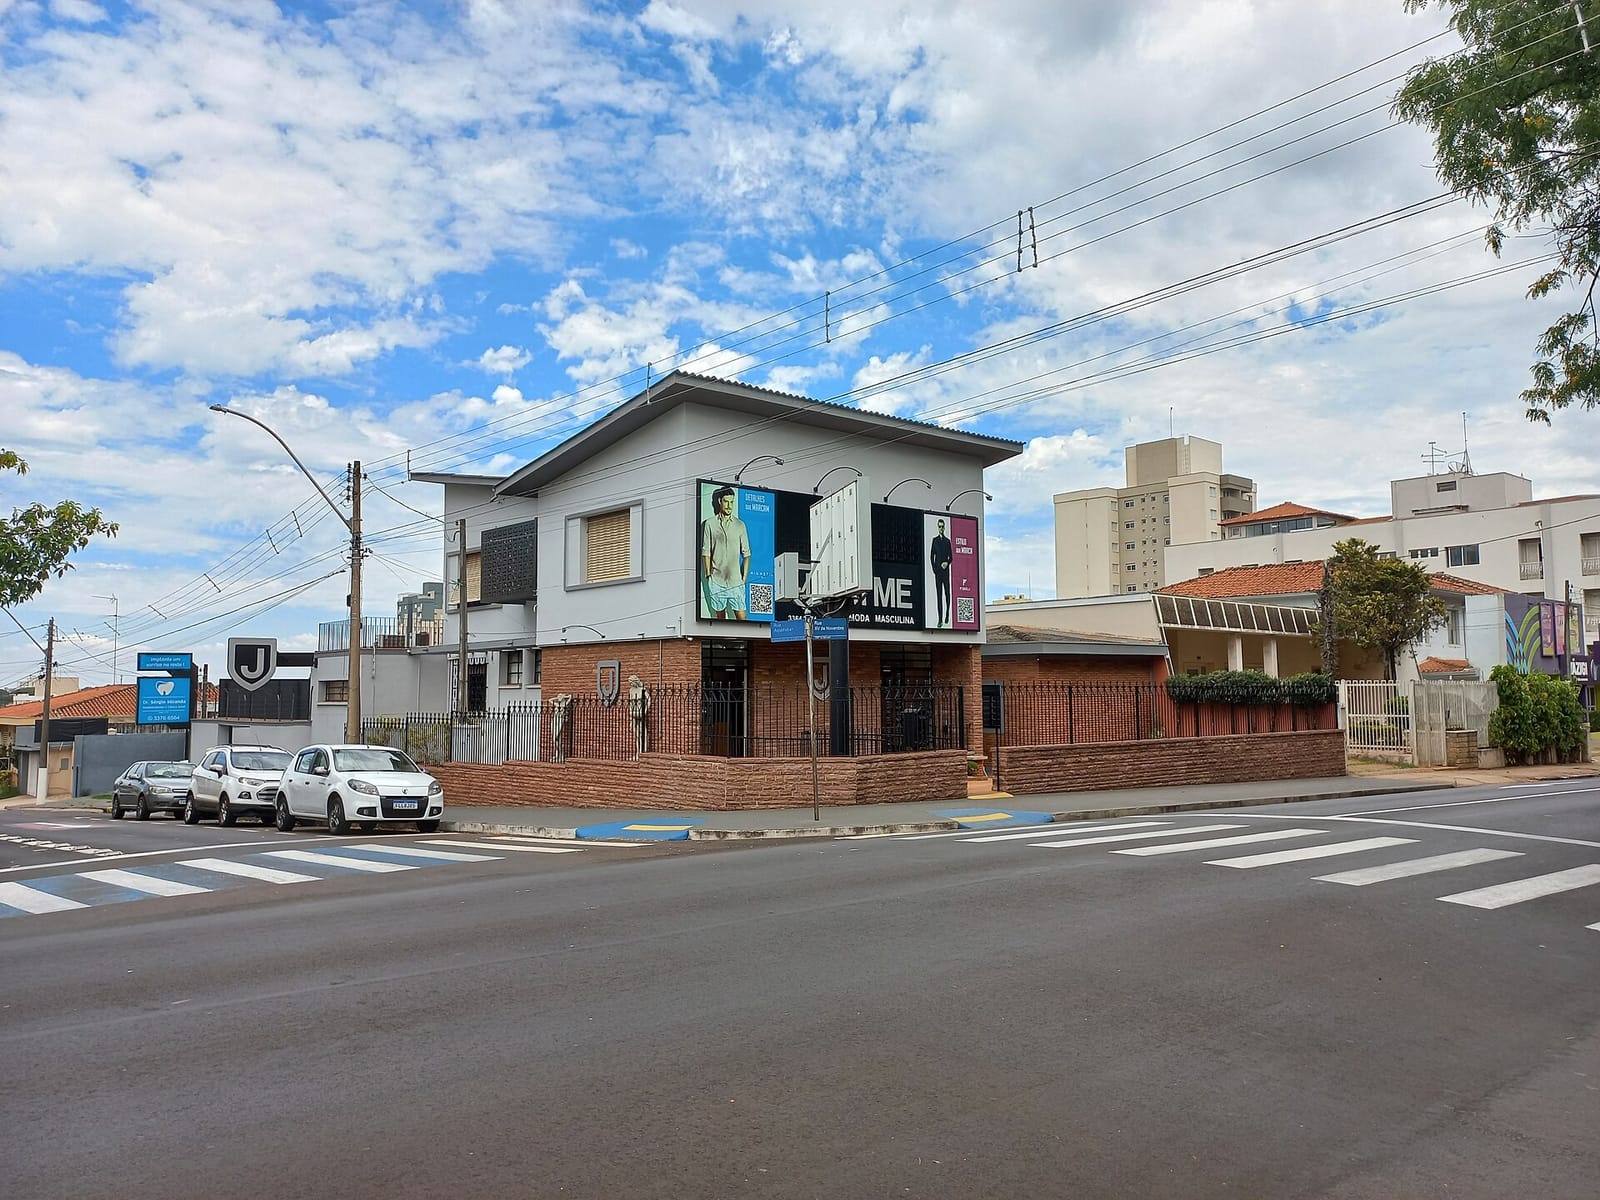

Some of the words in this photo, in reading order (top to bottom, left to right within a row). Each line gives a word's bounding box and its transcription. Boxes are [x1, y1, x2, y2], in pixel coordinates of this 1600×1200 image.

[848, 613, 871, 623] MODA
[874, 614, 915, 625] MASCULINA
[240, 647, 265, 679] J
